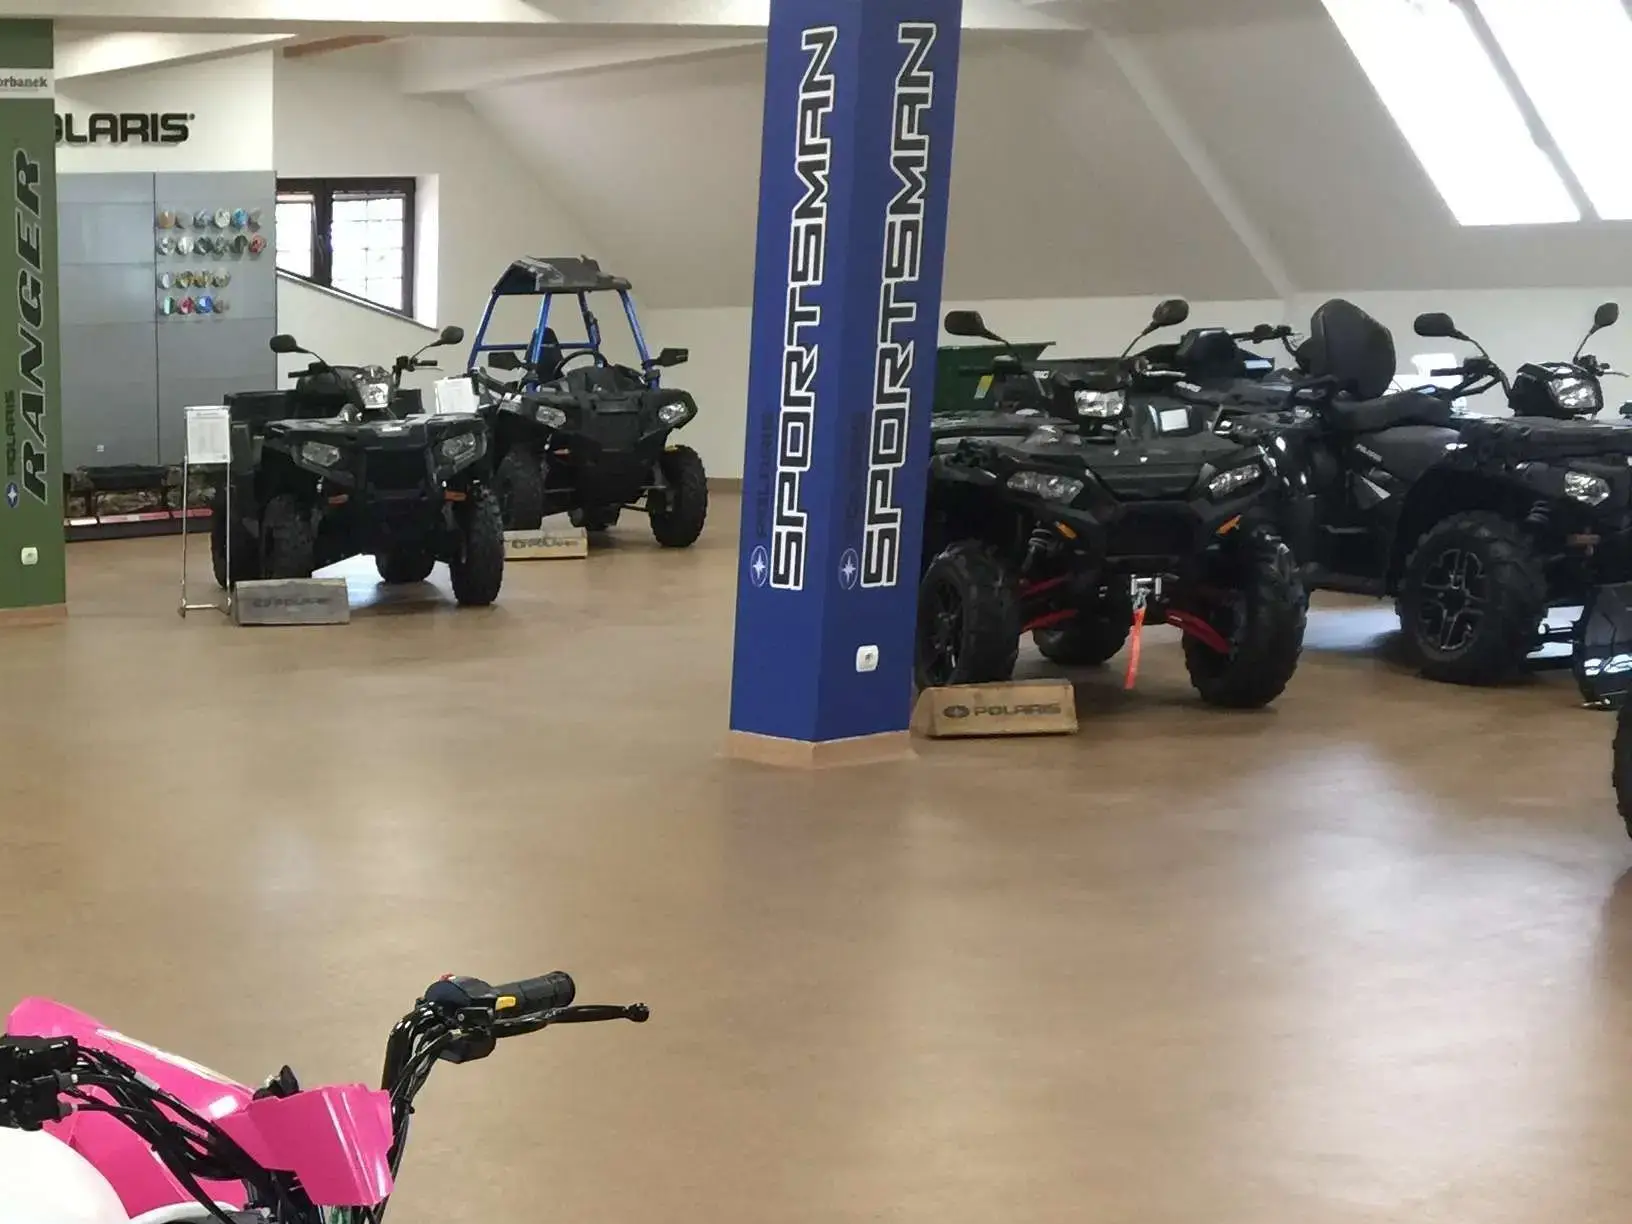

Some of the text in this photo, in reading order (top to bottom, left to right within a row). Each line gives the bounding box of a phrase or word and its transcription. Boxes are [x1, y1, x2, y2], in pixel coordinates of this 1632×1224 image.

[54, 113, 189, 143] LARIS
[860, 22, 937, 588] SPORTSMAN
[14, 148, 48, 504] RANGER
[769, 26, 838, 591] SPORTSMAN
[974, 702, 1062, 717] POLARIS
